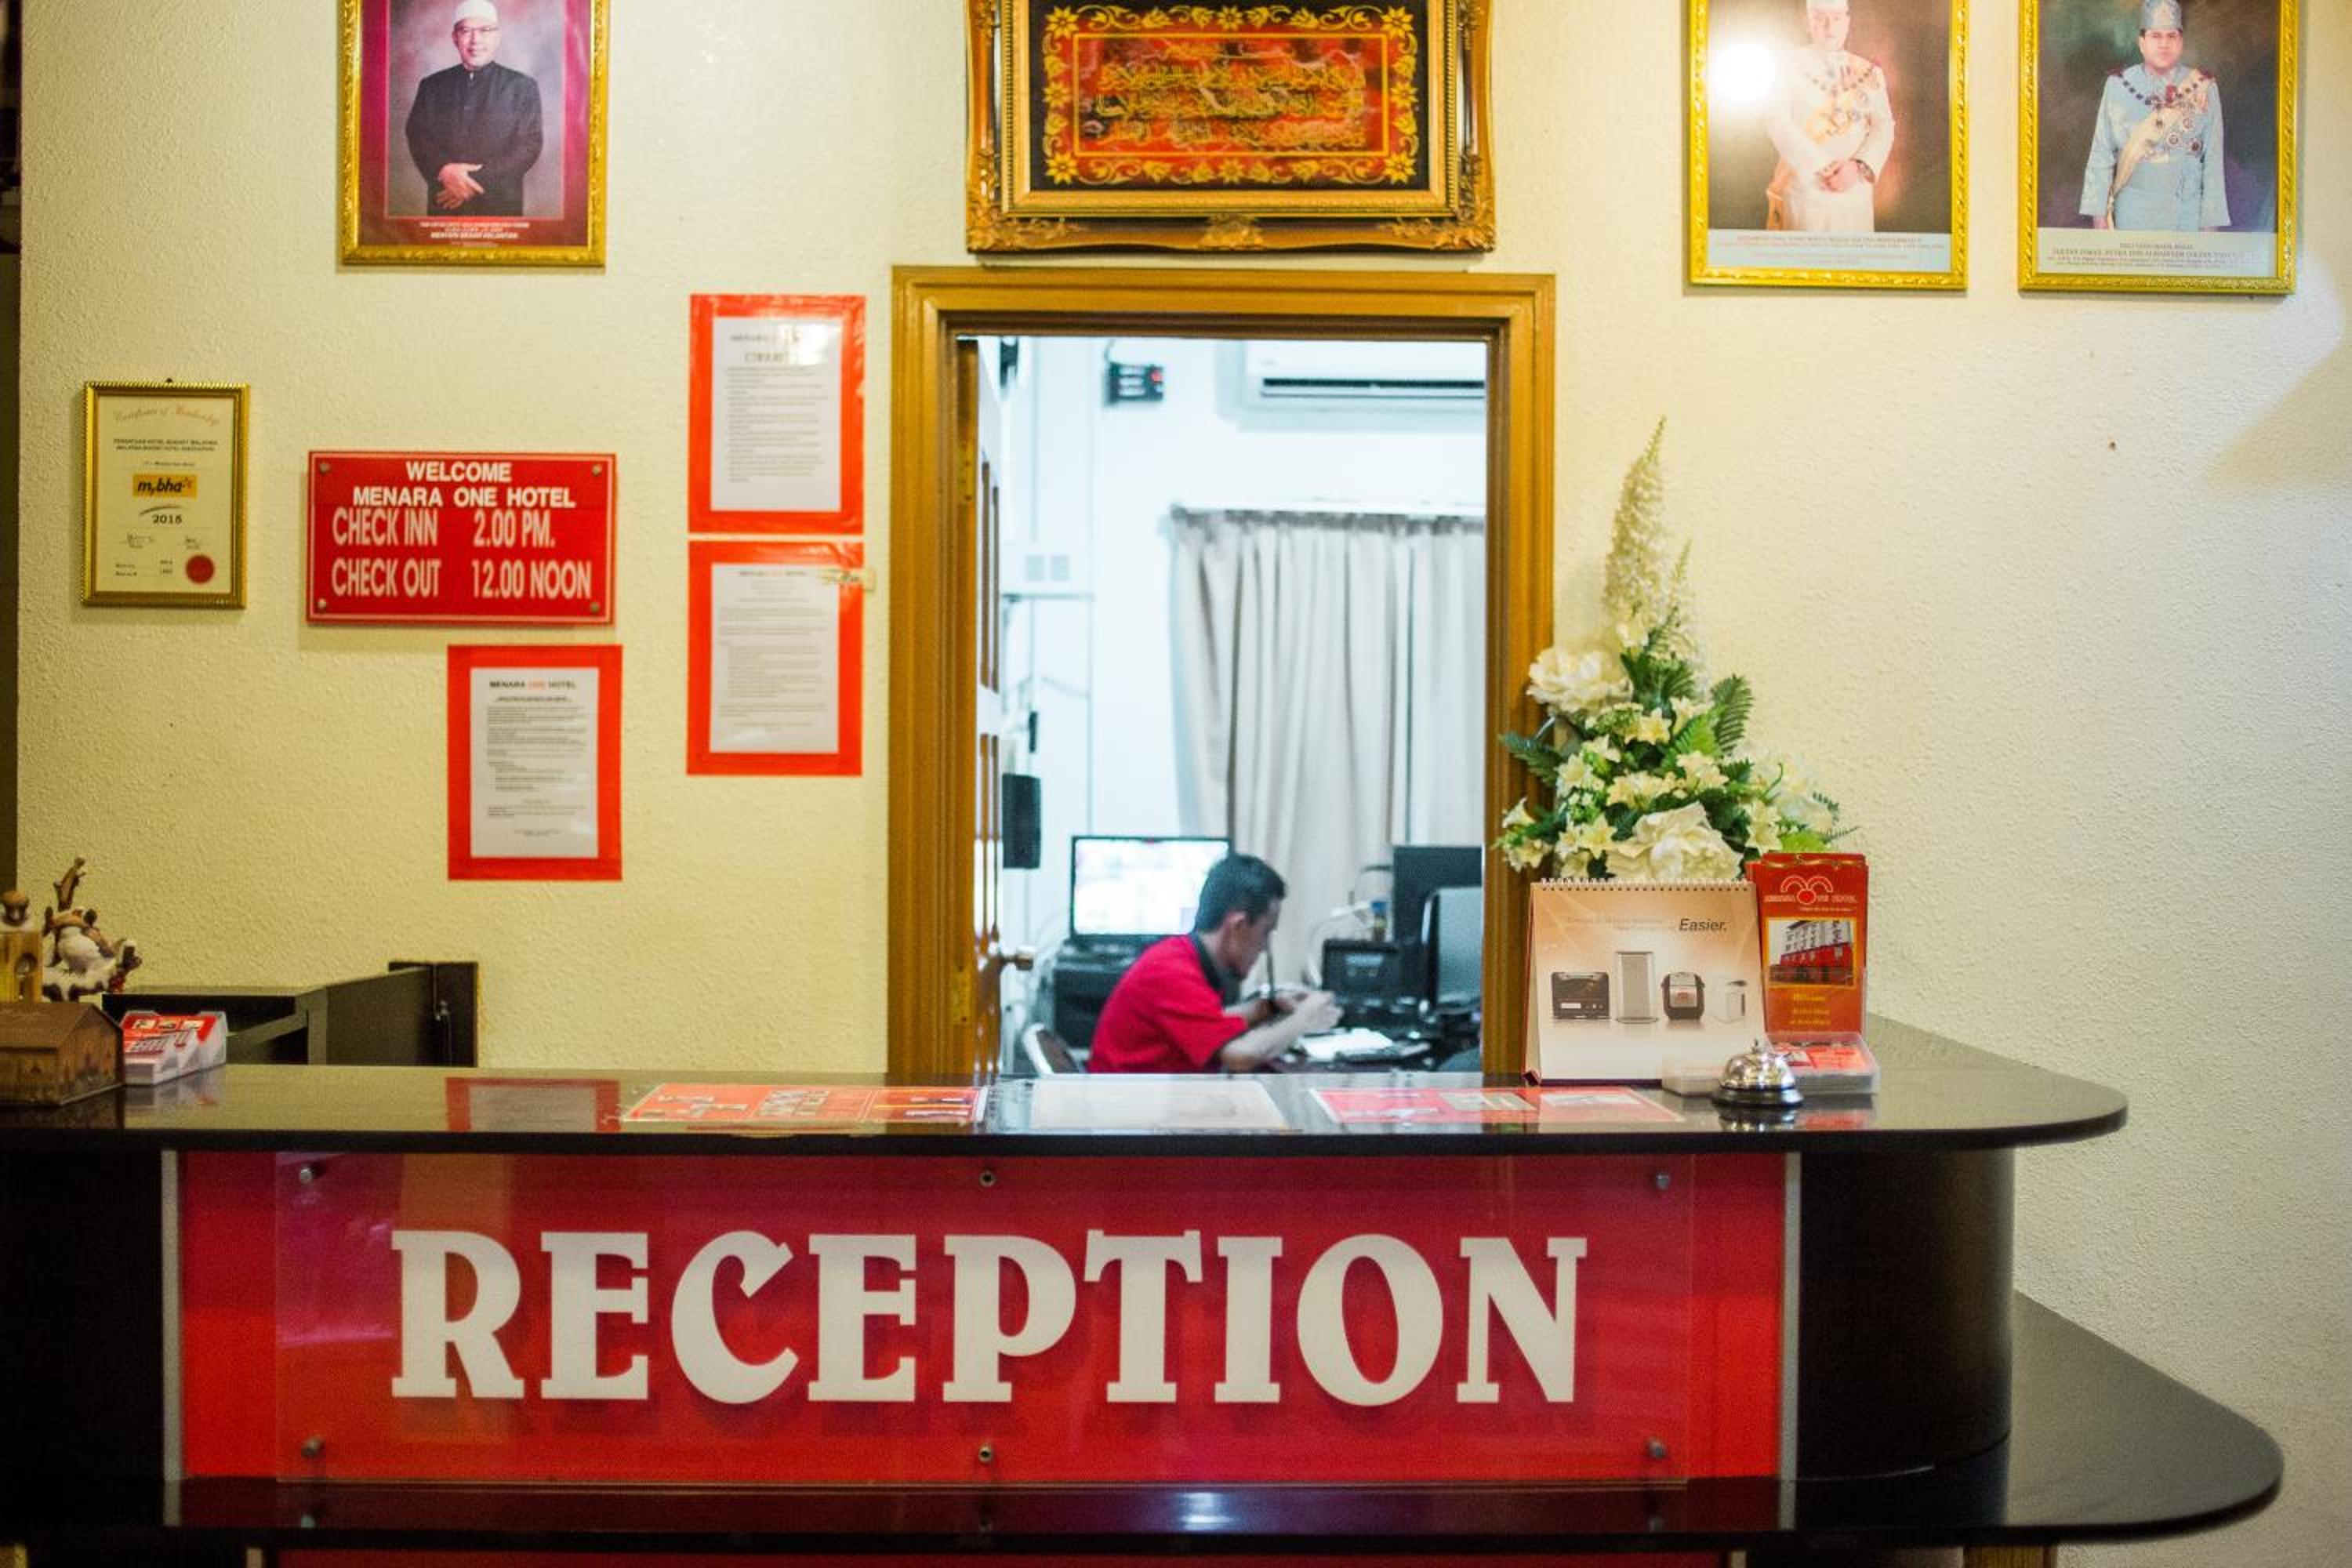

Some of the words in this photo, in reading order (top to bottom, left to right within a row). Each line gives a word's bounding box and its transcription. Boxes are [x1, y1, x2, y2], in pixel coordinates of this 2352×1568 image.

[406, 461, 512, 482] WELCOME
[353, 487, 444, 507] MENARA
[453, 488, 498, 508] ONE
[506, 488, 576, 508] HOTEL
[332, 507, 398, 546] CHECK
[405, 509, 438, 546] INN
[473, 510, 516, 547] 2.00
[521, 510, 556, 547] PM.
[332, 558, 397, 597] CHECK
[403, 559, 441, 597] OUT
[472, 560, 525, 597] 12.00
[530, 561, 592, 599] NOON
[1679, 918, 1728, 933] Easier.
[393, 1230, 1586, 1405] RECEPTION
